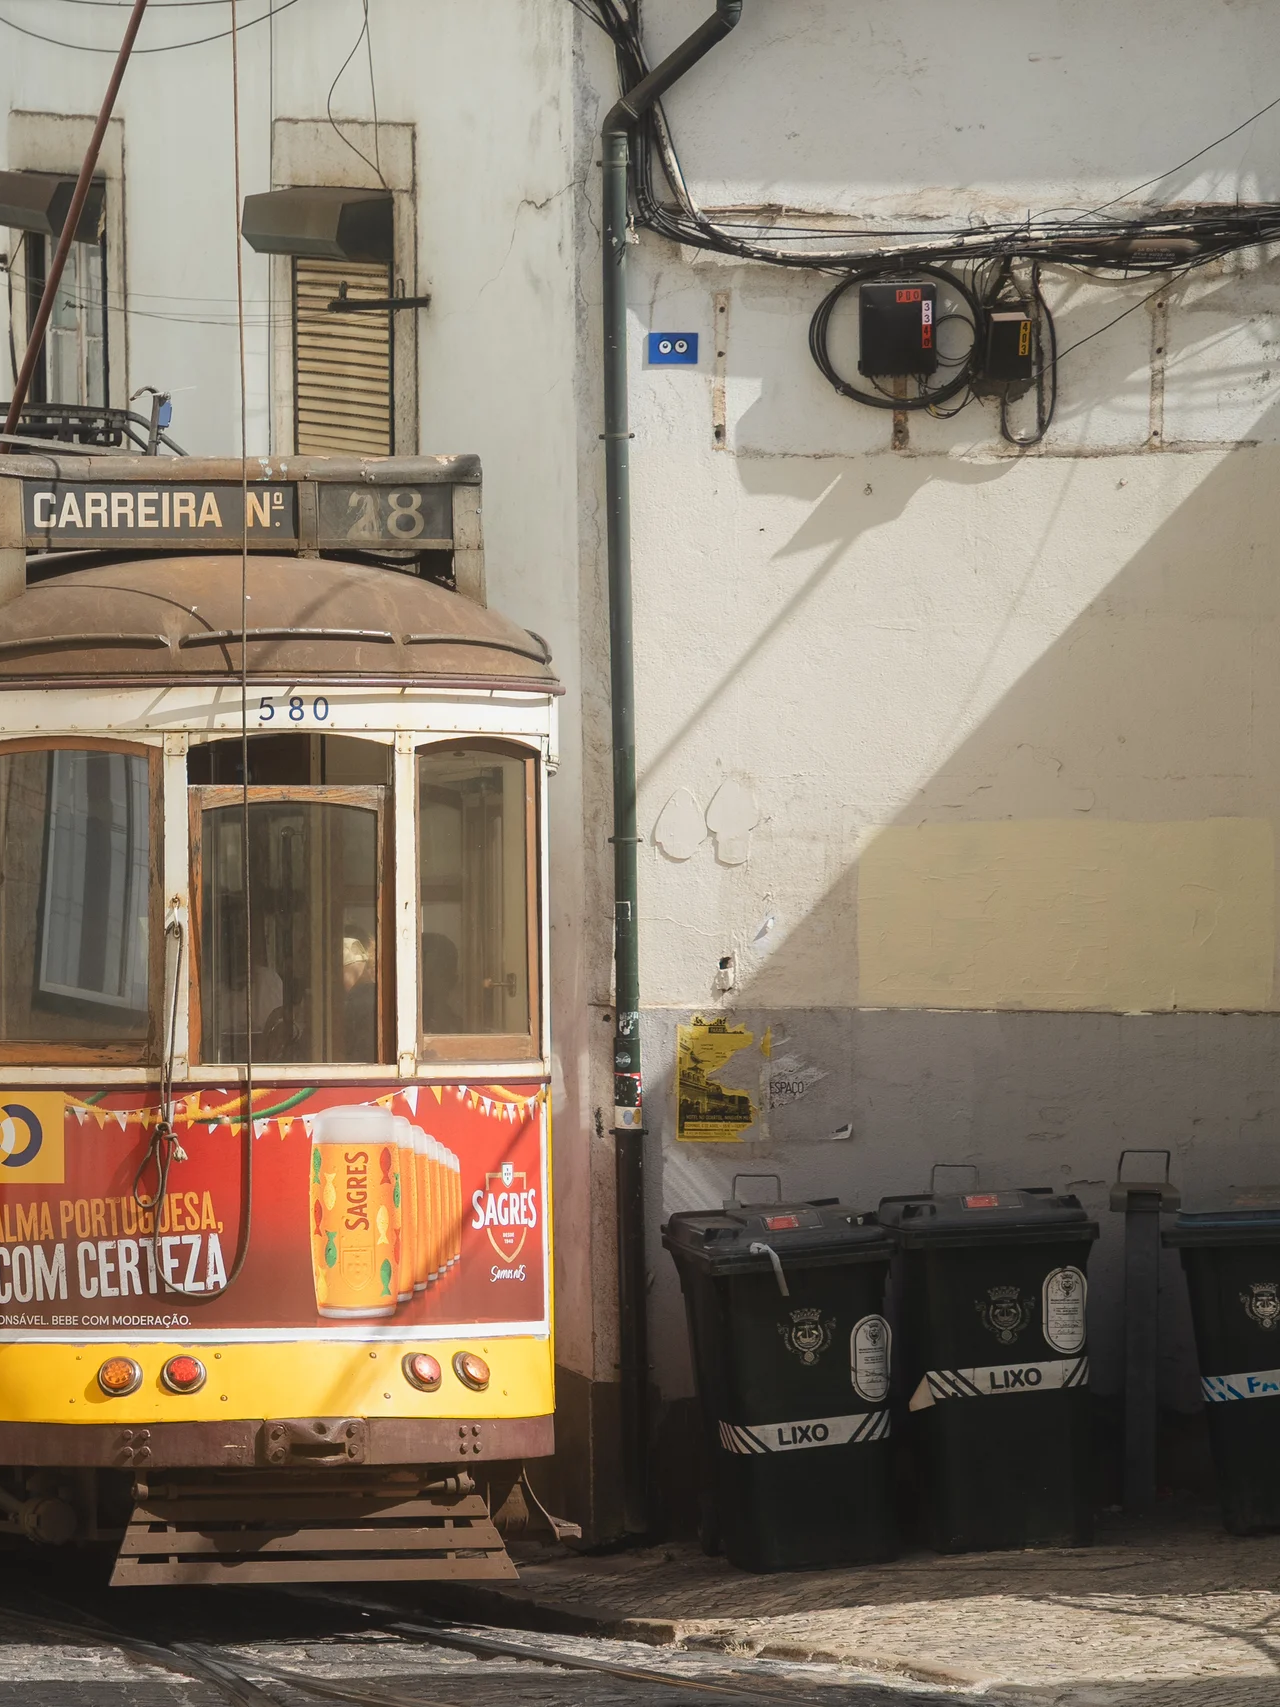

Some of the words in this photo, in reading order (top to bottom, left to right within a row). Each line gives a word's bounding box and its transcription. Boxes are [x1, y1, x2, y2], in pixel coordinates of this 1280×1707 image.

[33, 491, 223, 529] CARREIRA
[346, 486, 425, 541] 28
[259, 696, 330, 722] 580
[770, 1081, 804, 1096] ESPAÇO
[344, 1151, 370, 1231] SAGRES
[471, 1188, 537, 1230] SAGRES
[76, 1232, 228, 1300] CERTEZA
[51, 1315, 79, 1326] BEBE
[81, 1315, 109, 1326] COM
[112, 1313, 192, 1329] MODERAÇÃO.
[989, 1367, 1042, 1390] LIXO
[777, 1423, 829, 1446] LIXO
